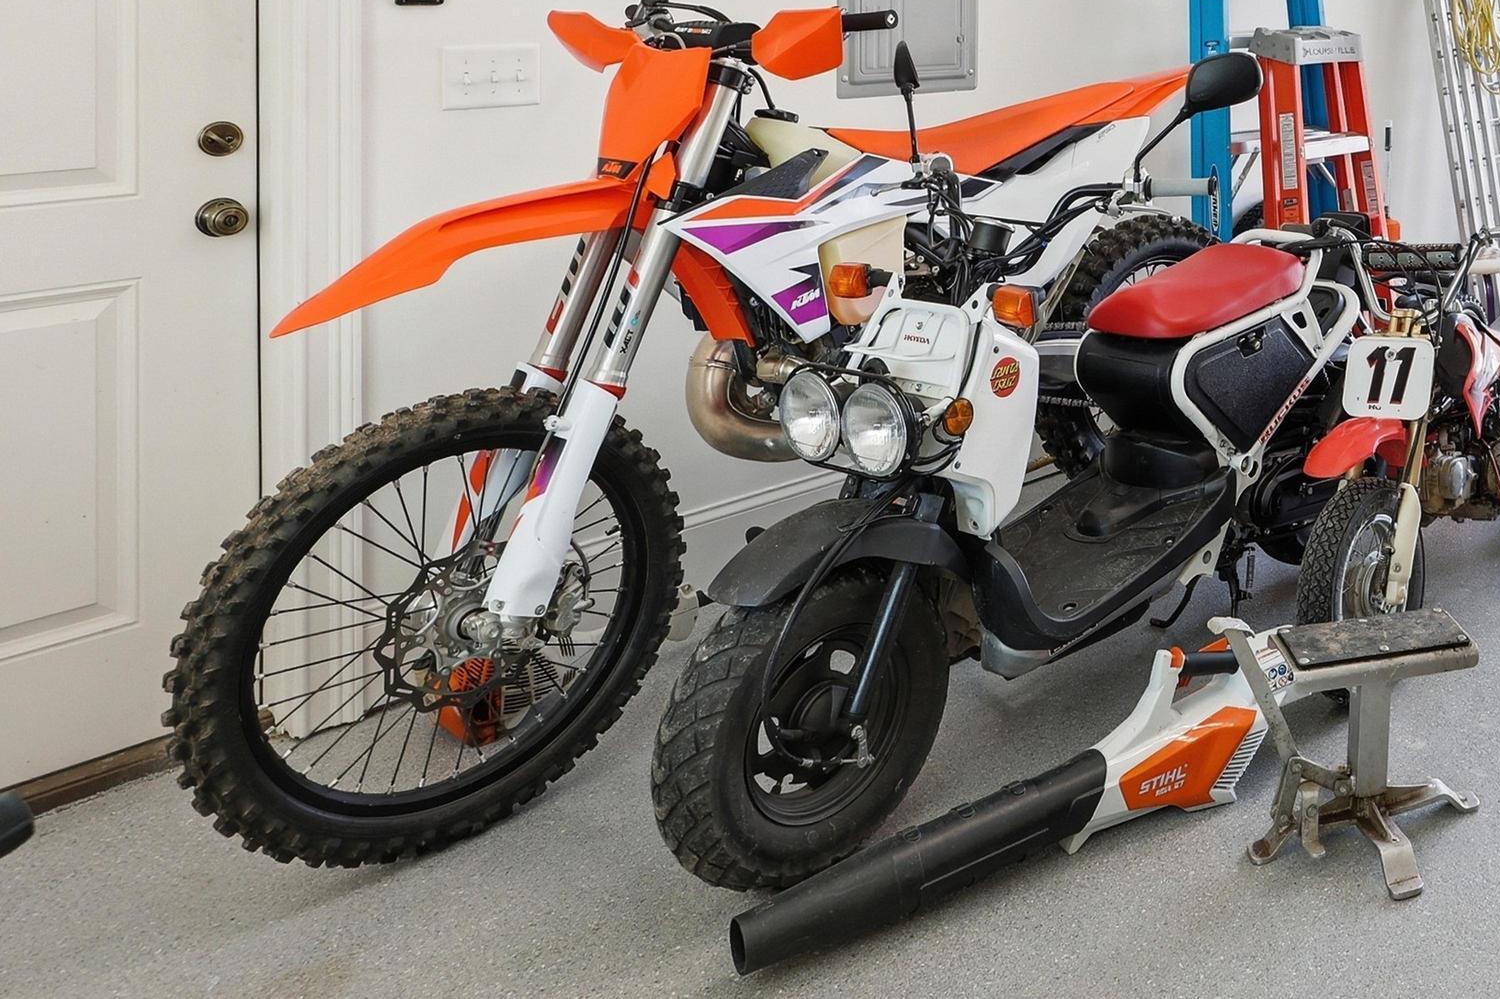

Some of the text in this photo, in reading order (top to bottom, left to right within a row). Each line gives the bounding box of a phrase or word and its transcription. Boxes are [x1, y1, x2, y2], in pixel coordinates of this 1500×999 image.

[601, 161, 622, 174] KTM
[790, 287, 821, 311] KTM
[619, 329, 634, 355] XACT
[903, 334, 930, 345] HONDA
[1366, 346, 1416, 404] 11
[1260, 377, 1310, 445] RUCKUS
[1138, 766, 1187, 795] STIHL
